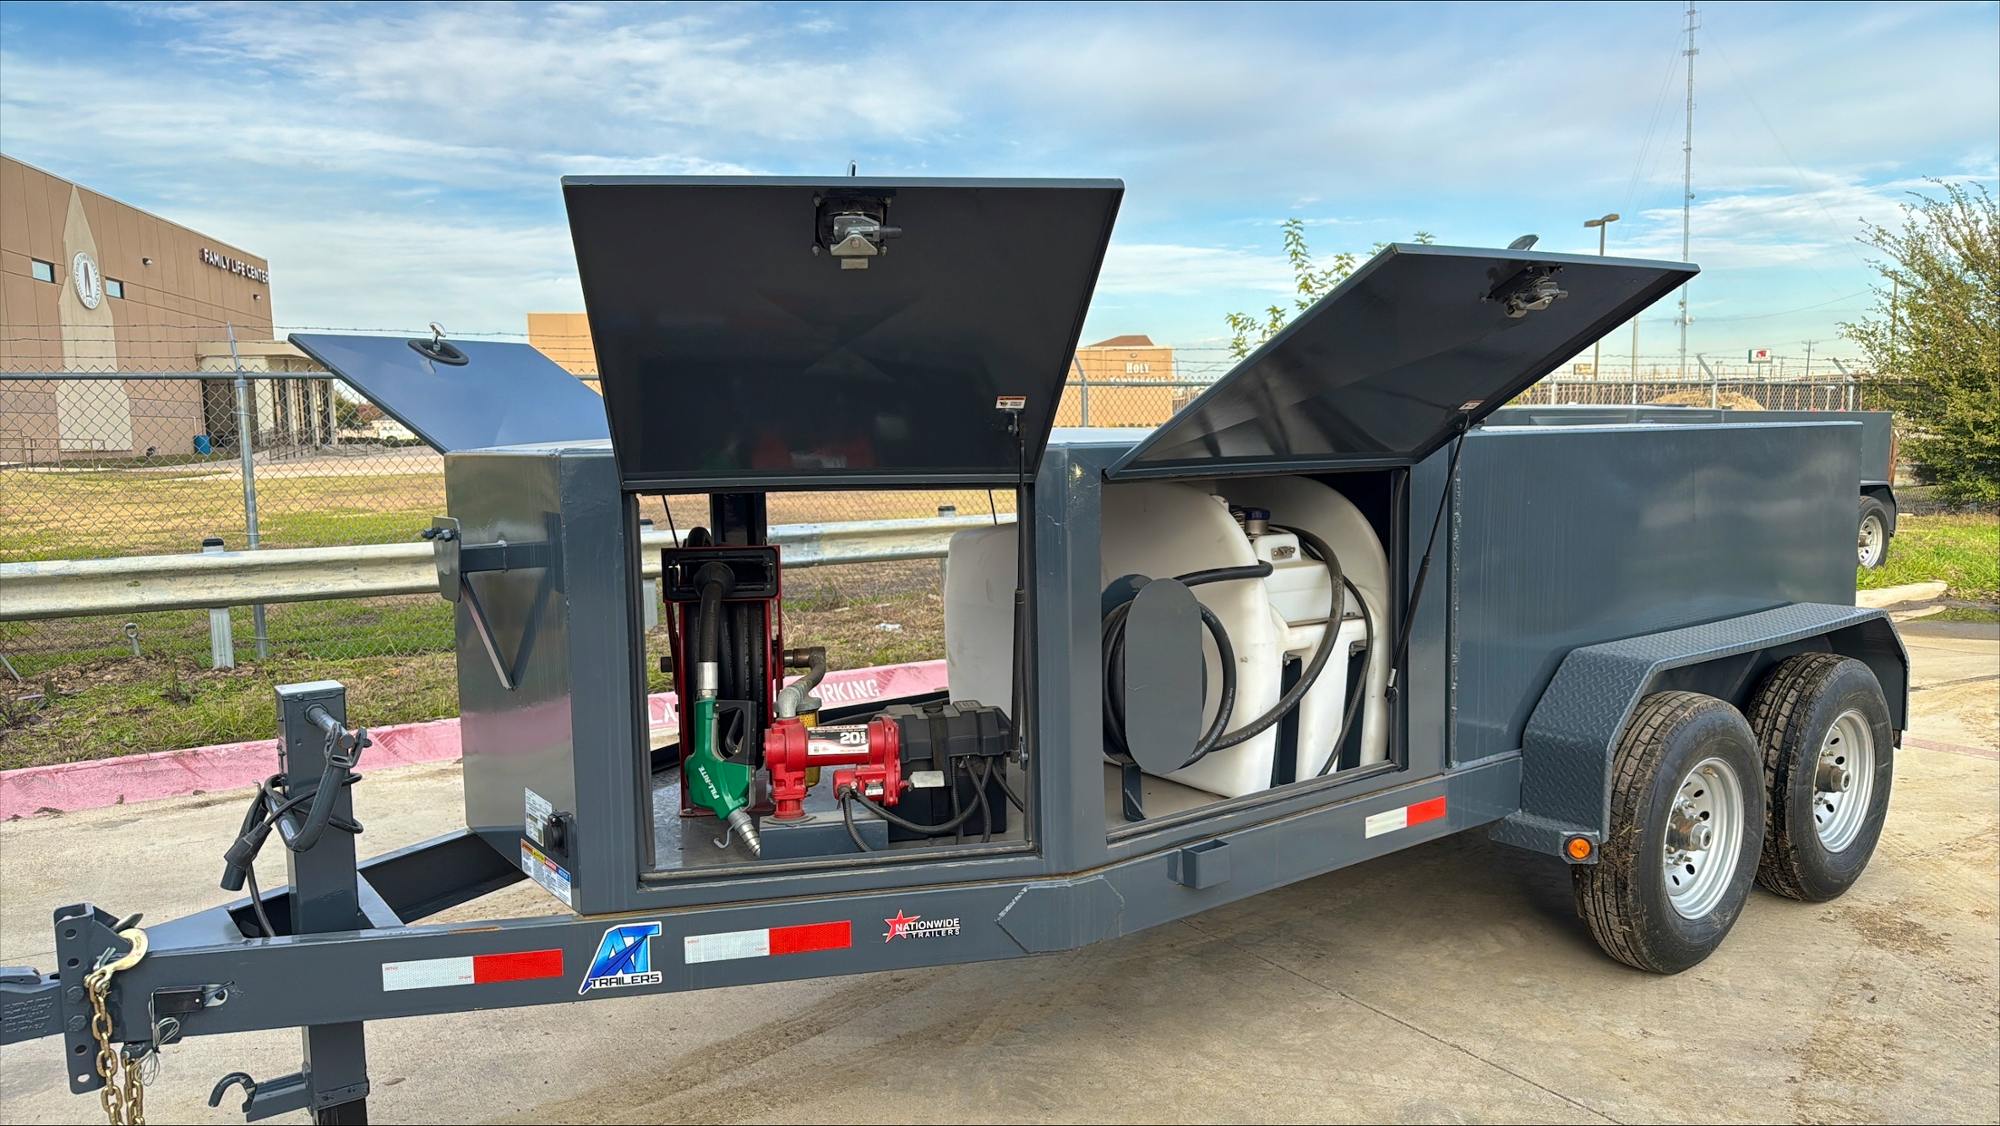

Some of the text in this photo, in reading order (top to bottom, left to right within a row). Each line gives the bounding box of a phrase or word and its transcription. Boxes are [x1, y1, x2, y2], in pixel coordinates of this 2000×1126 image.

[203, 248, 230, 271] FAMILY
[231, 258, 246, 277] LIFE
[1126, 361, 1150, 375] HOLY
[839, 731, 860, 745] 20
[895, 918, 960, 932] NATIONWIDE
[912, 928, 960, 939] TRAILERS
[591, 973, 660, 988] TRAILERS
